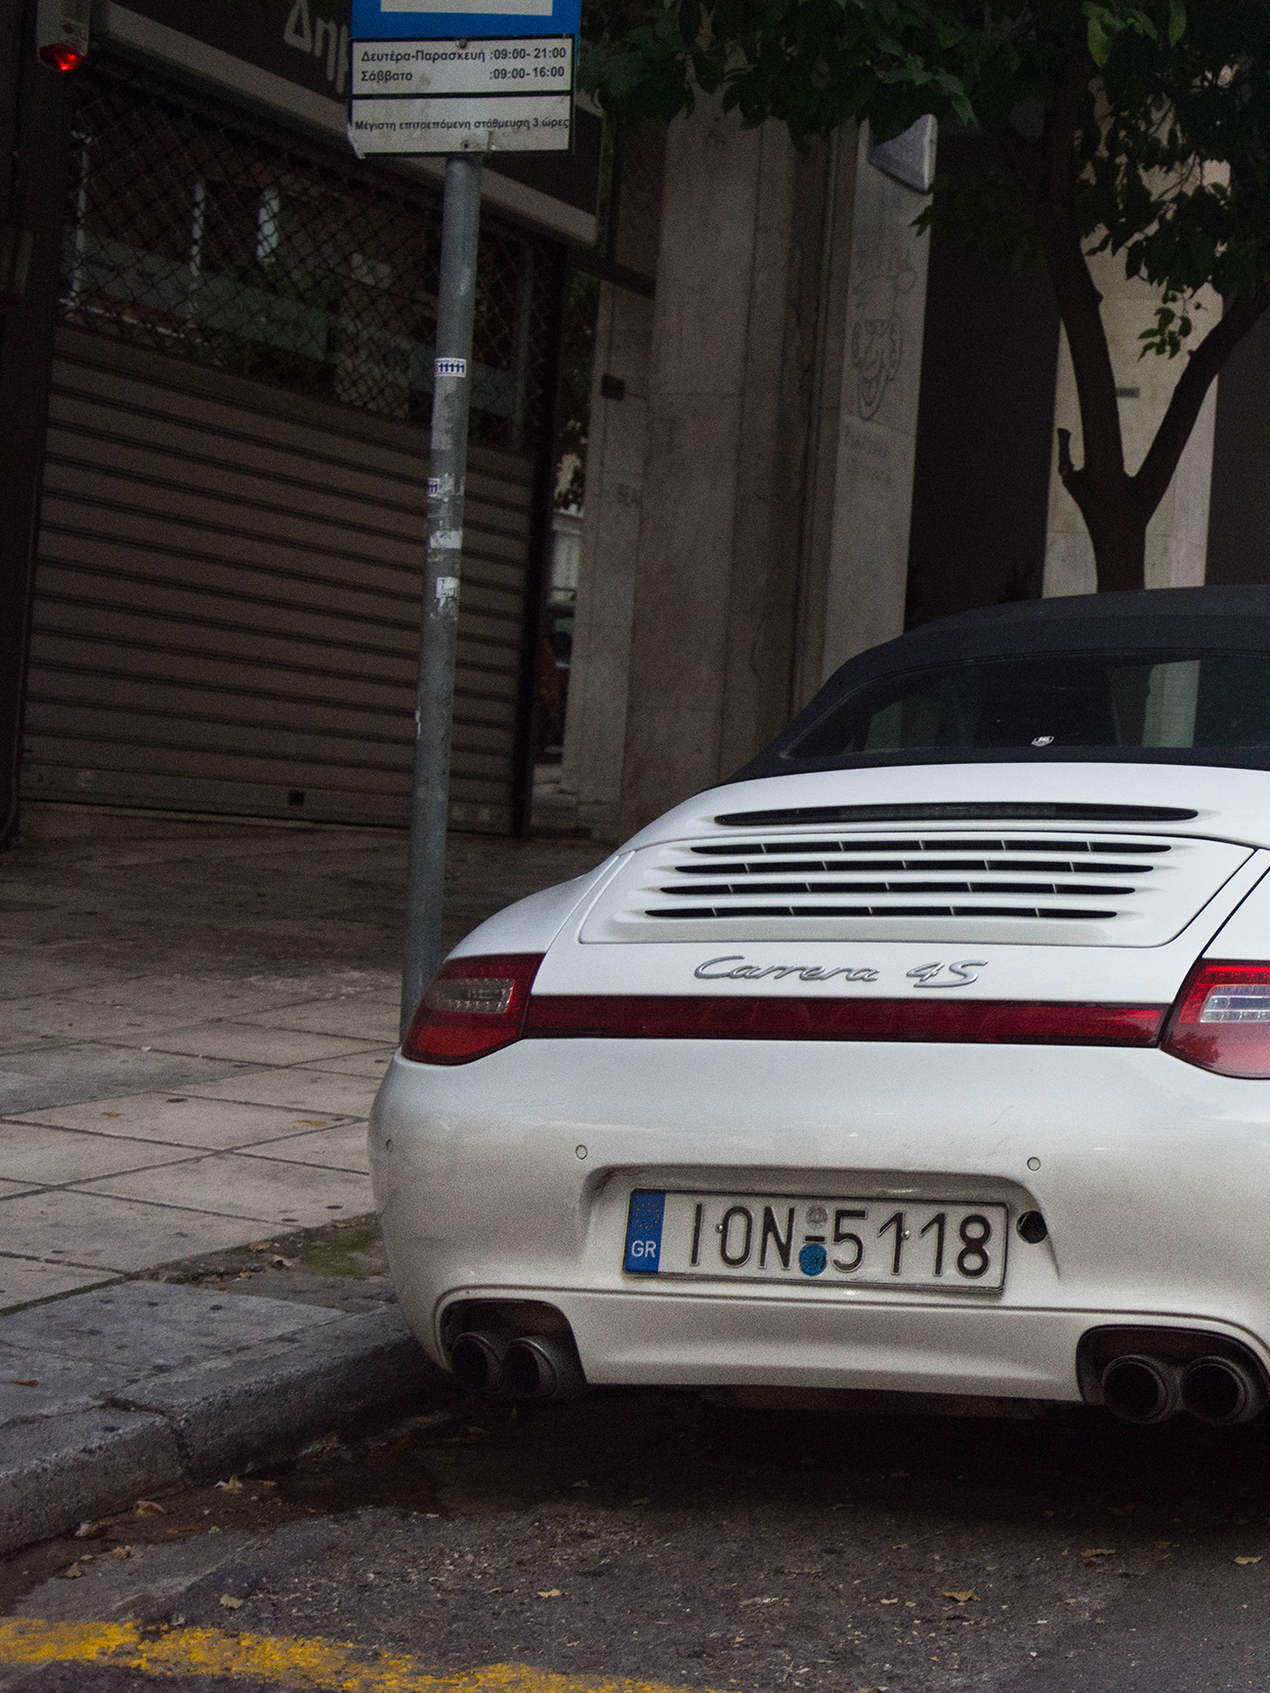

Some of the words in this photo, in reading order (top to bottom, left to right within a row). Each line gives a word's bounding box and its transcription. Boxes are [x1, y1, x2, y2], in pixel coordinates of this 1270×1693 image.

[361, 49, 486, 63] Δευτέρα-Παρασκευή
[533, 47, 567, 59] 21:00
[361, 70, 413, 83] Σάββατο
[532, 66, 565, 77] 16:00
[354, 120, 396, 132] Μέγιστη
[399, 119, 471, 130] επιτρεπόμενη
[473, 118, 530, 130] στάθμευση
[532, 117, 540, 128] 3
[541, 116, 569, 128] ώρες
[694, 955, 880, 982] Carrera
[906, 959, 989, 988] 4S
[631, 1240, 657, 1258] GR
